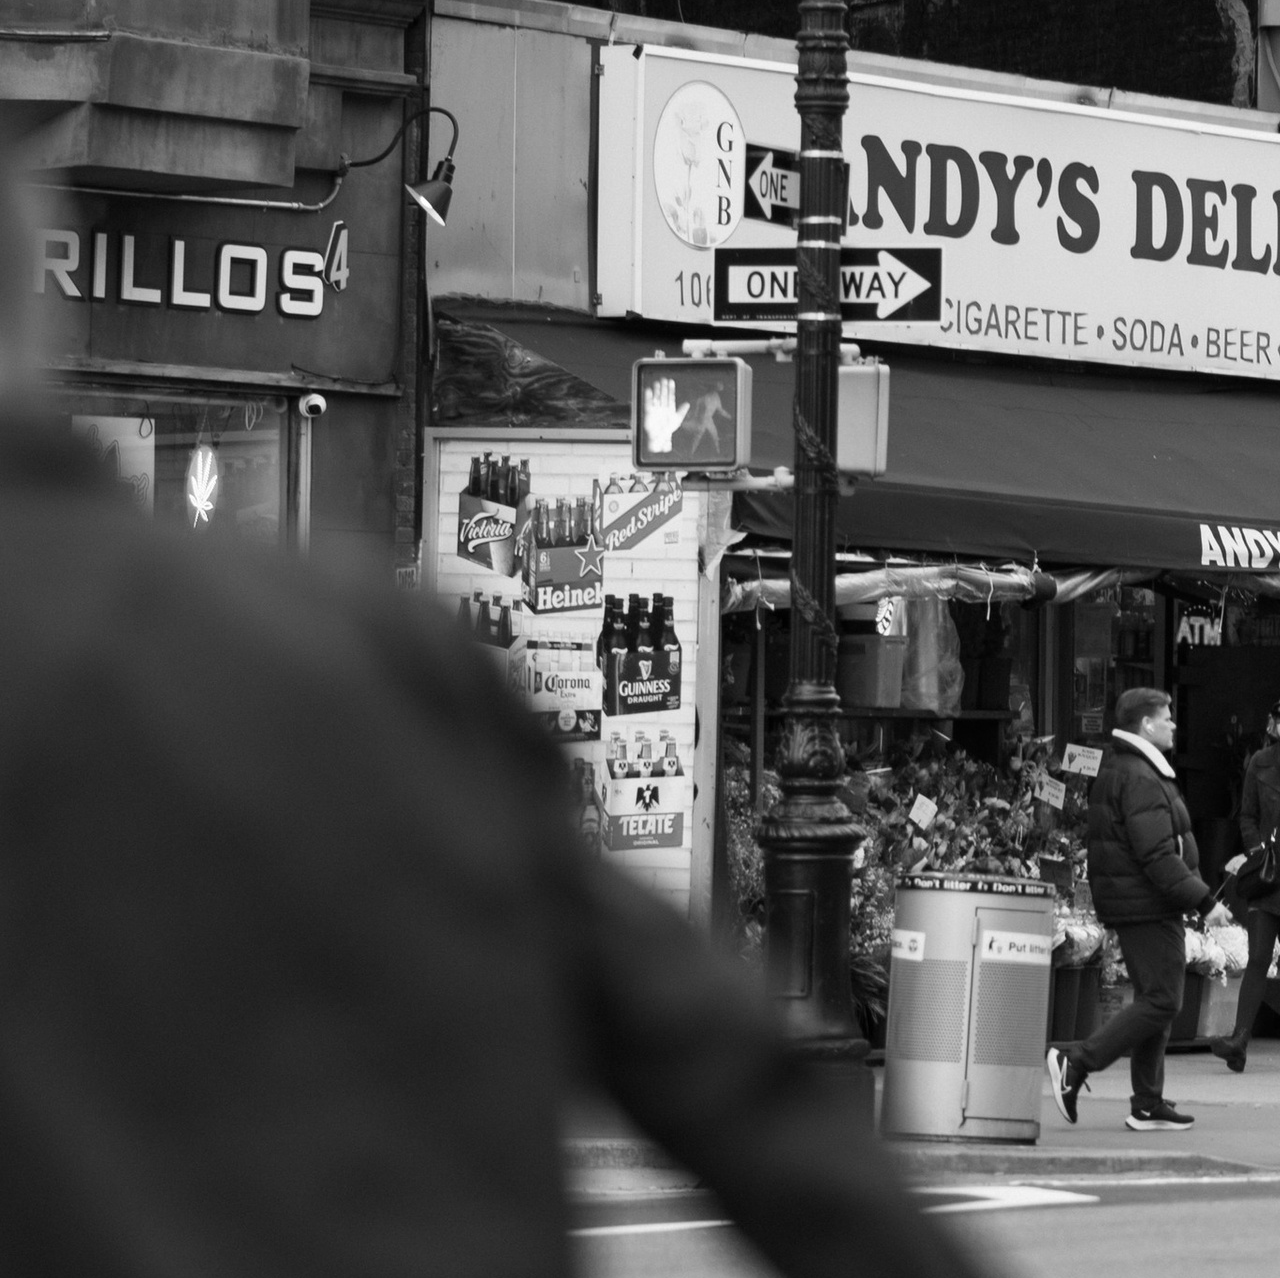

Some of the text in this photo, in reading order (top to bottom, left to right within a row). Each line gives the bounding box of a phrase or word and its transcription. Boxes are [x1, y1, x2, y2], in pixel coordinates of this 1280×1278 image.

[759, 170, 788, 202] ONE
[849, 134, 1101, 254] NDY'S
[841, 271, 906, 299] WAY
[1112, 317, 1184, 356] SODA
[1206, 327, 1272, 365] BEER
[460, 510, 513, 552] Victoria
[605, 489, 682, 552] Red Stripe
[1177, 616, 1221, 646] ATM
[545, 674, 591, 695] Corona
[619, 679, 671, 696] GUINNESS
[628, 693, 663, 704] DRAUGHT
[619, 814, 676, 836] TECATE
[914, 877, 971, 891] Don't litter
[1009, 942, 1026, 952] Put
